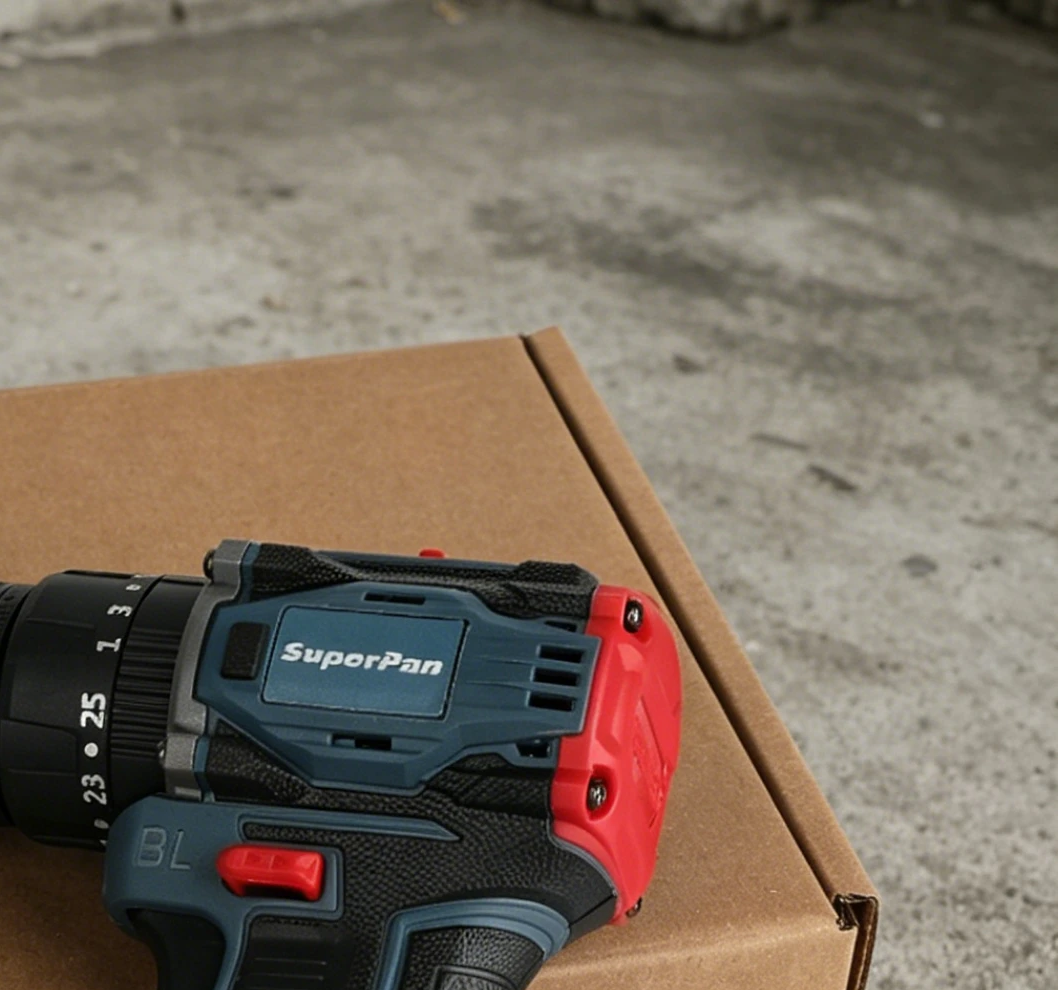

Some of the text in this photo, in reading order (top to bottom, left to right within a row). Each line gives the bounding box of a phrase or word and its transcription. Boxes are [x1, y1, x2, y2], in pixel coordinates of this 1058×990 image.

[280, 641, 443, 676] SuporPan
[80, 603, 133, 805] 23 25 1 3
[136, 826, 191, 870] BL
